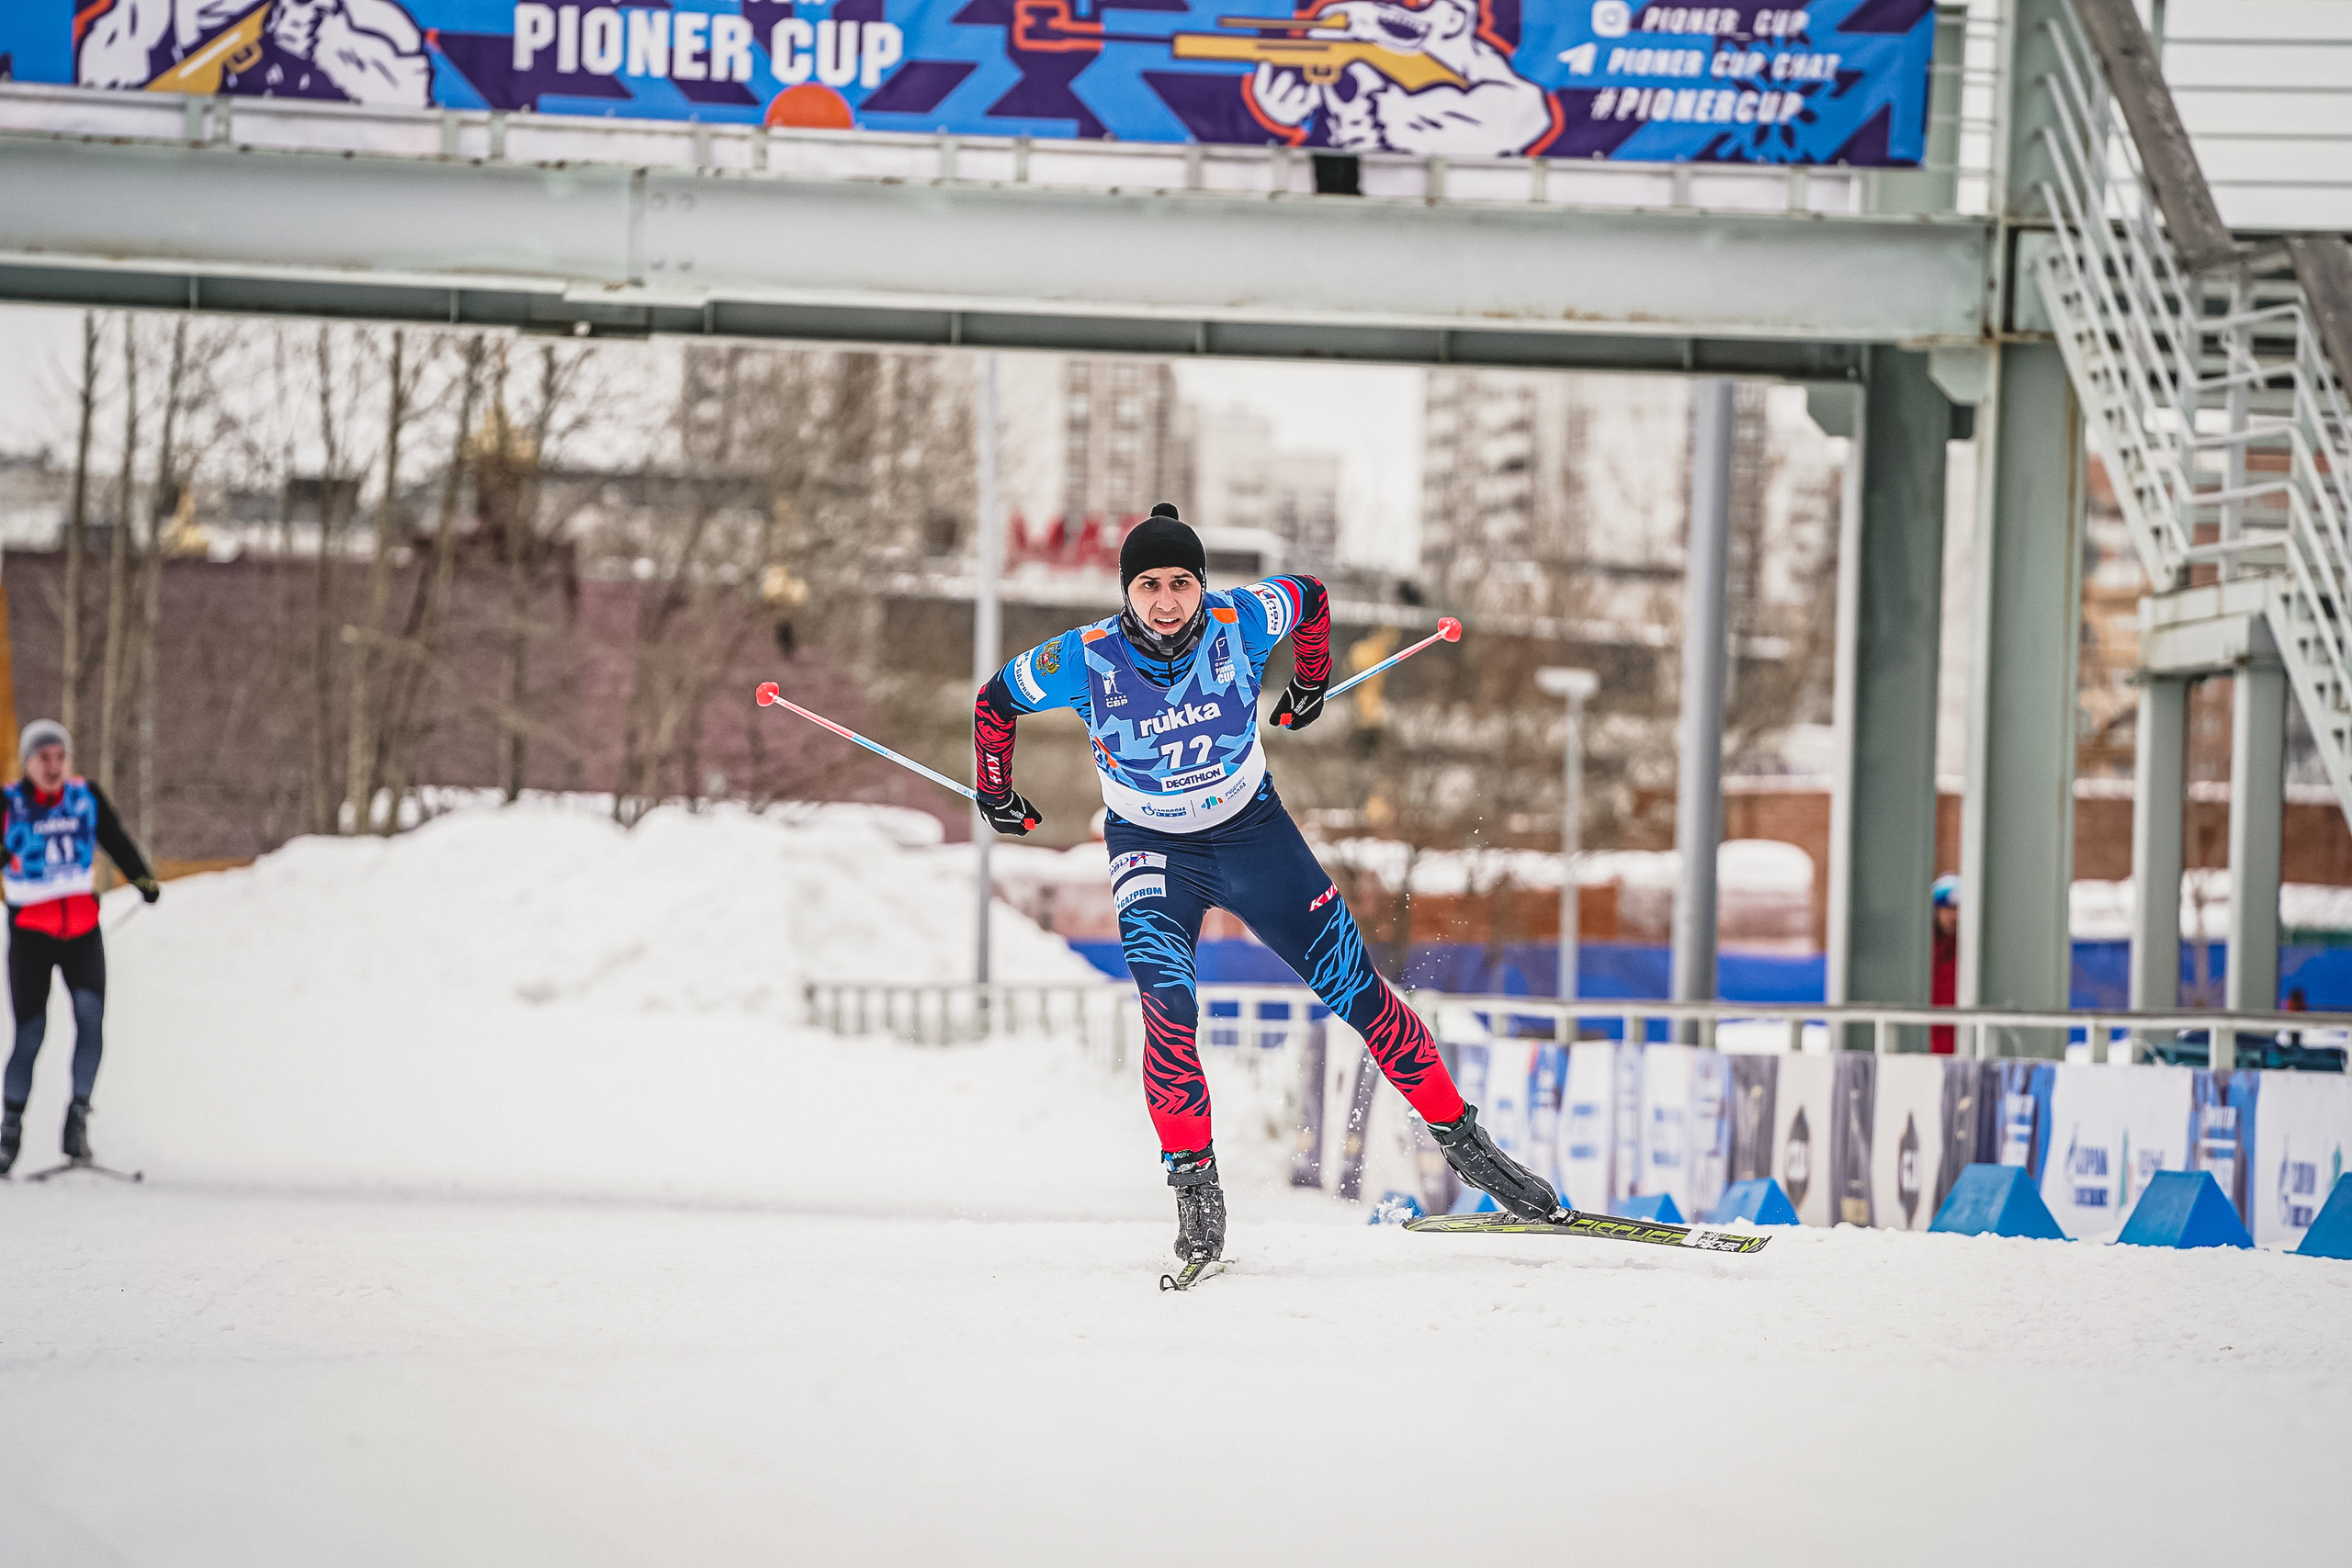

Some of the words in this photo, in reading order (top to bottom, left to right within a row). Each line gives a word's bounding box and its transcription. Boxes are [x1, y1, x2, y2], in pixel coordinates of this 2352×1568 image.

[513, 3, 753, 82] PIONER
[771, 17, 903, 88] CUP
[1607, 48, 1704, 77] PIONER
[1711, 51, 1766, 79] CUP
[1771, 52, 1841, 80] CHAT
[1590, 86, 1805, 124] #PIONERCUP
[1015, 668, 1036, 702] GAZPROM
[1217, 671, 1236, 683] CUP
[1139, 702, 1222, 737] rukka
[1160, 734, 1213, 770] 72
[1165, 768, 1221, 789] DECATHLON
[1120, 886, 1162, 908] GAZPROM
